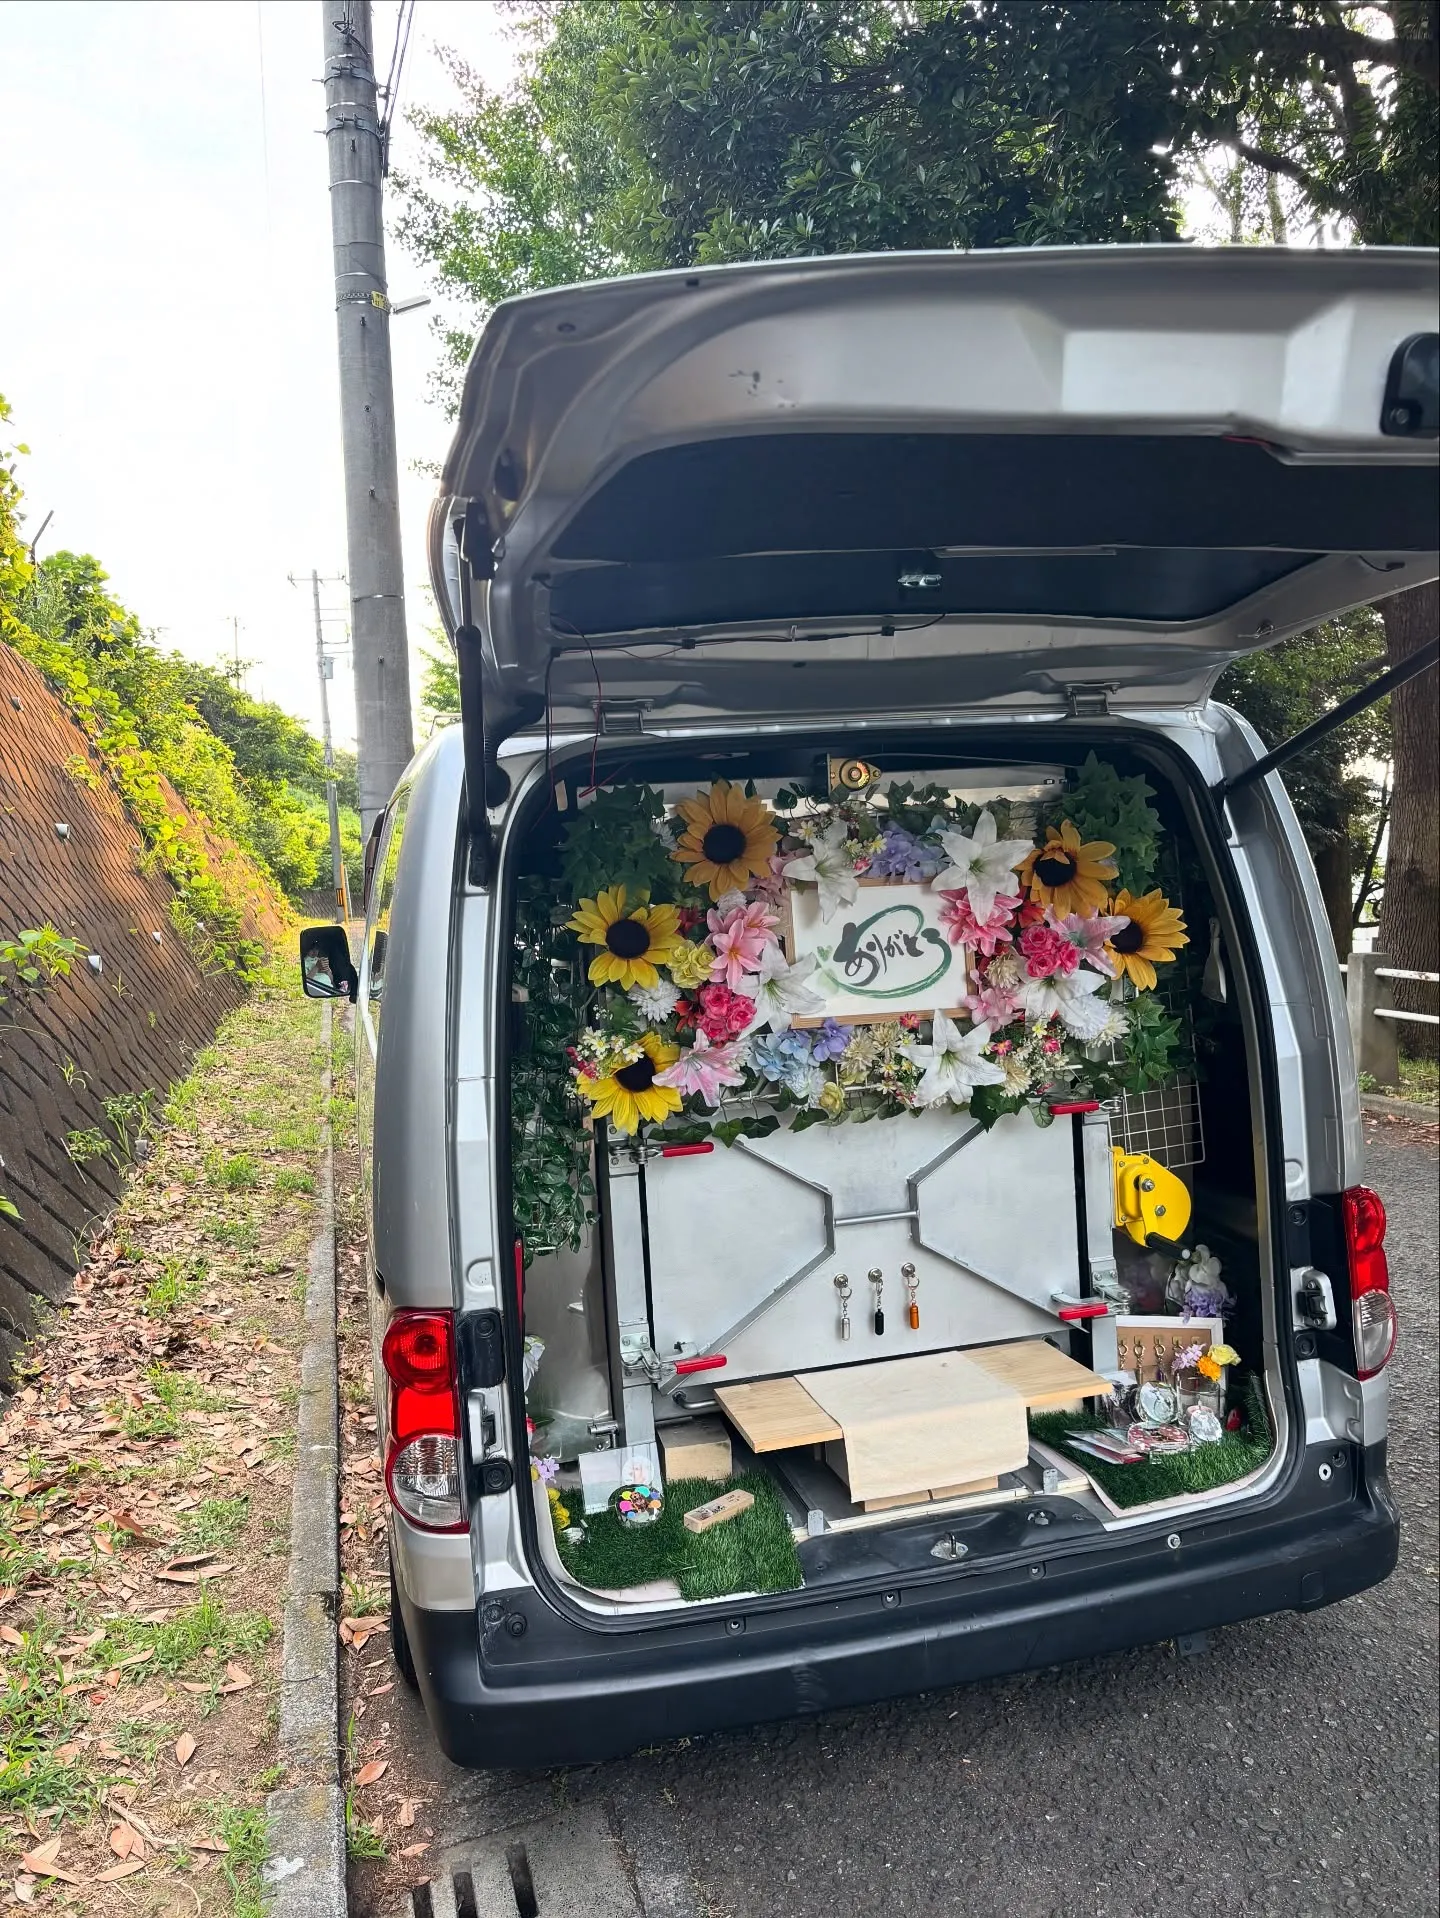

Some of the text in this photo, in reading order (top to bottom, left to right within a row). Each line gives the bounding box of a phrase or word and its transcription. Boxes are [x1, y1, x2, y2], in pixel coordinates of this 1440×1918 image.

[832, 906, 952, 998] ありがとう
